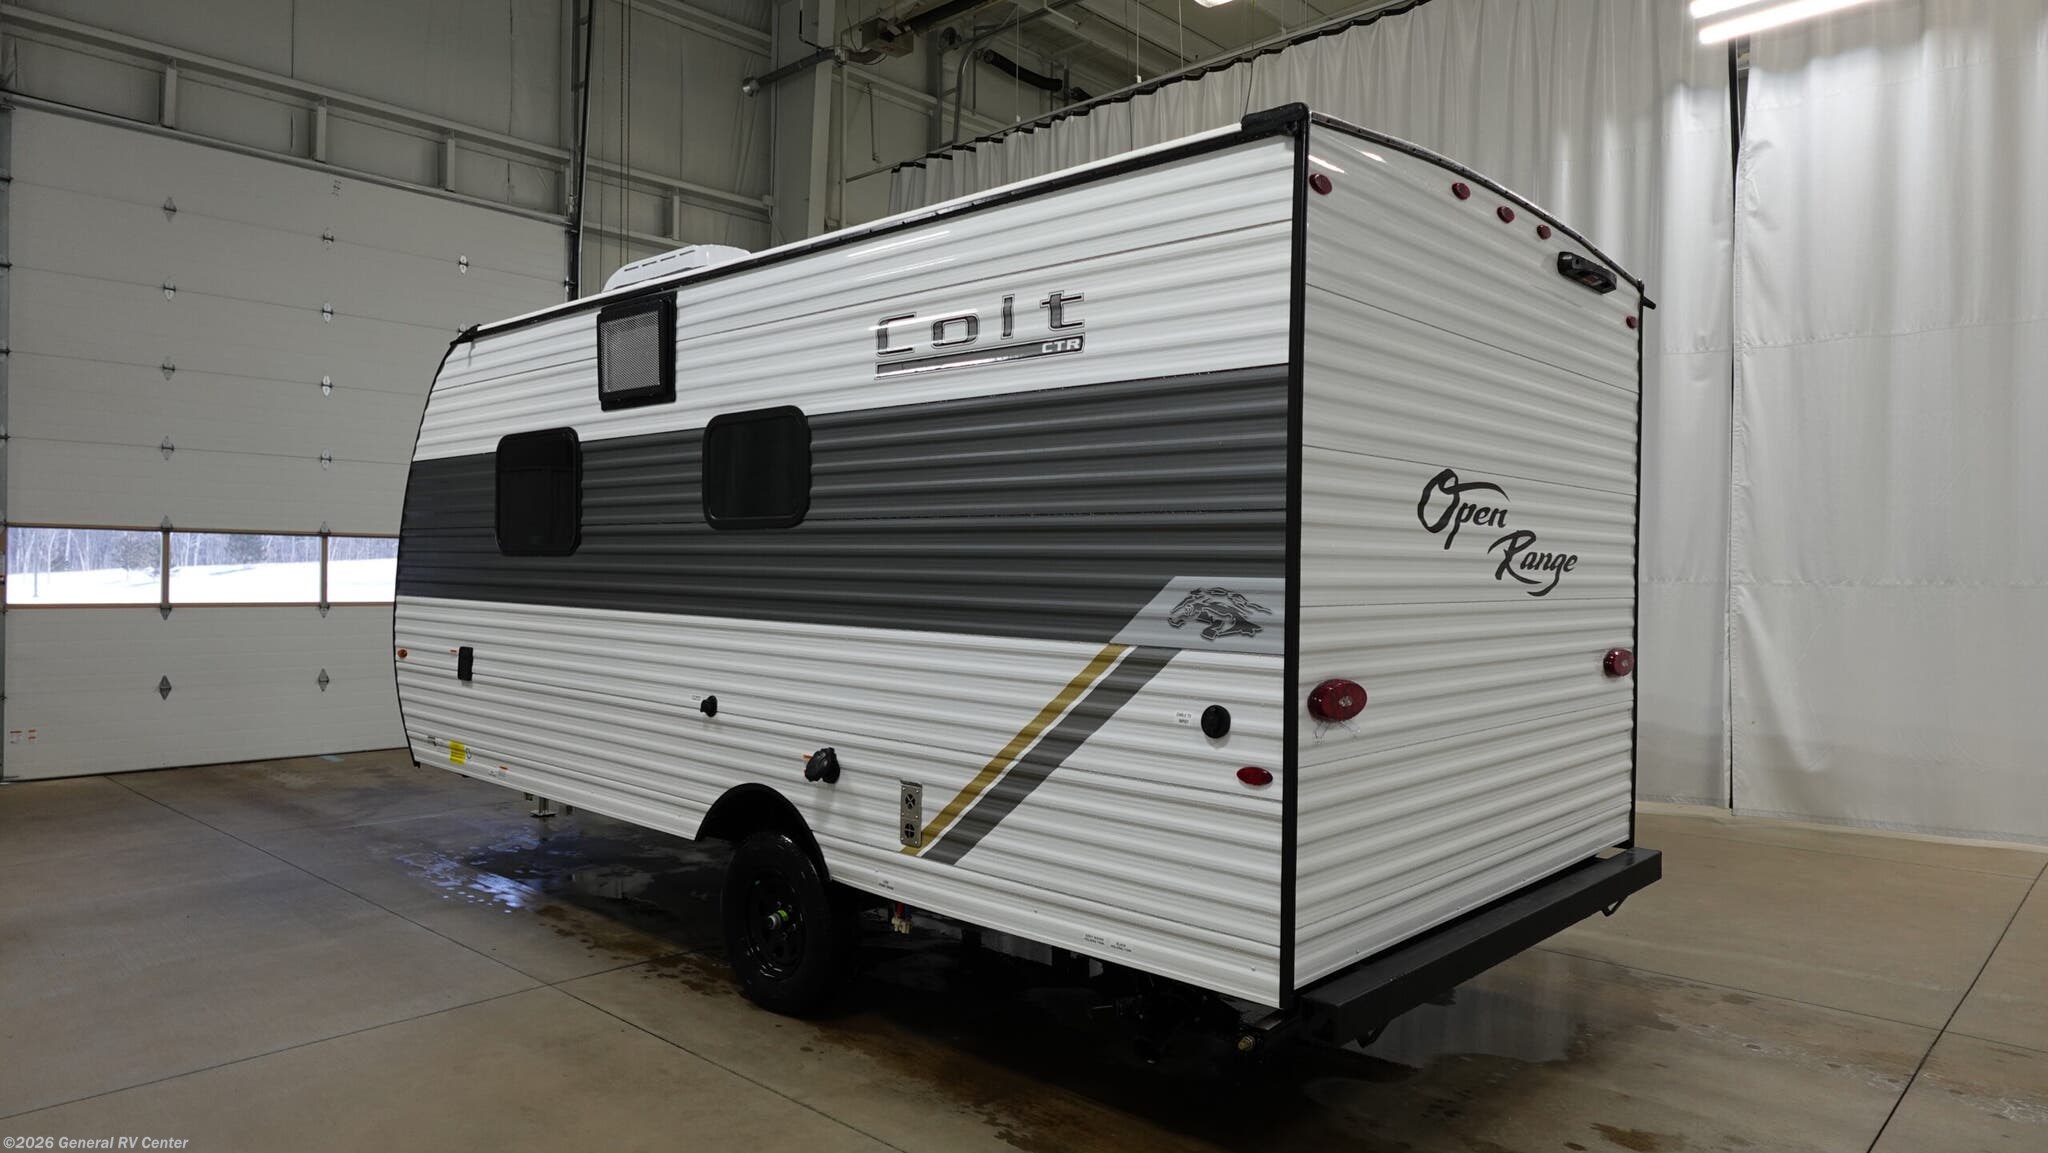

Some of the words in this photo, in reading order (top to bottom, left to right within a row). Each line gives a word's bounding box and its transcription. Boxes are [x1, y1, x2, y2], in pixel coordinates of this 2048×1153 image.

[876, 290, 1085, 357] Colt
[1041, 337, 1081, 354] CTR
[1417, 468, 1510, 550] Open
[1487, 530, 1578, 597] Range
